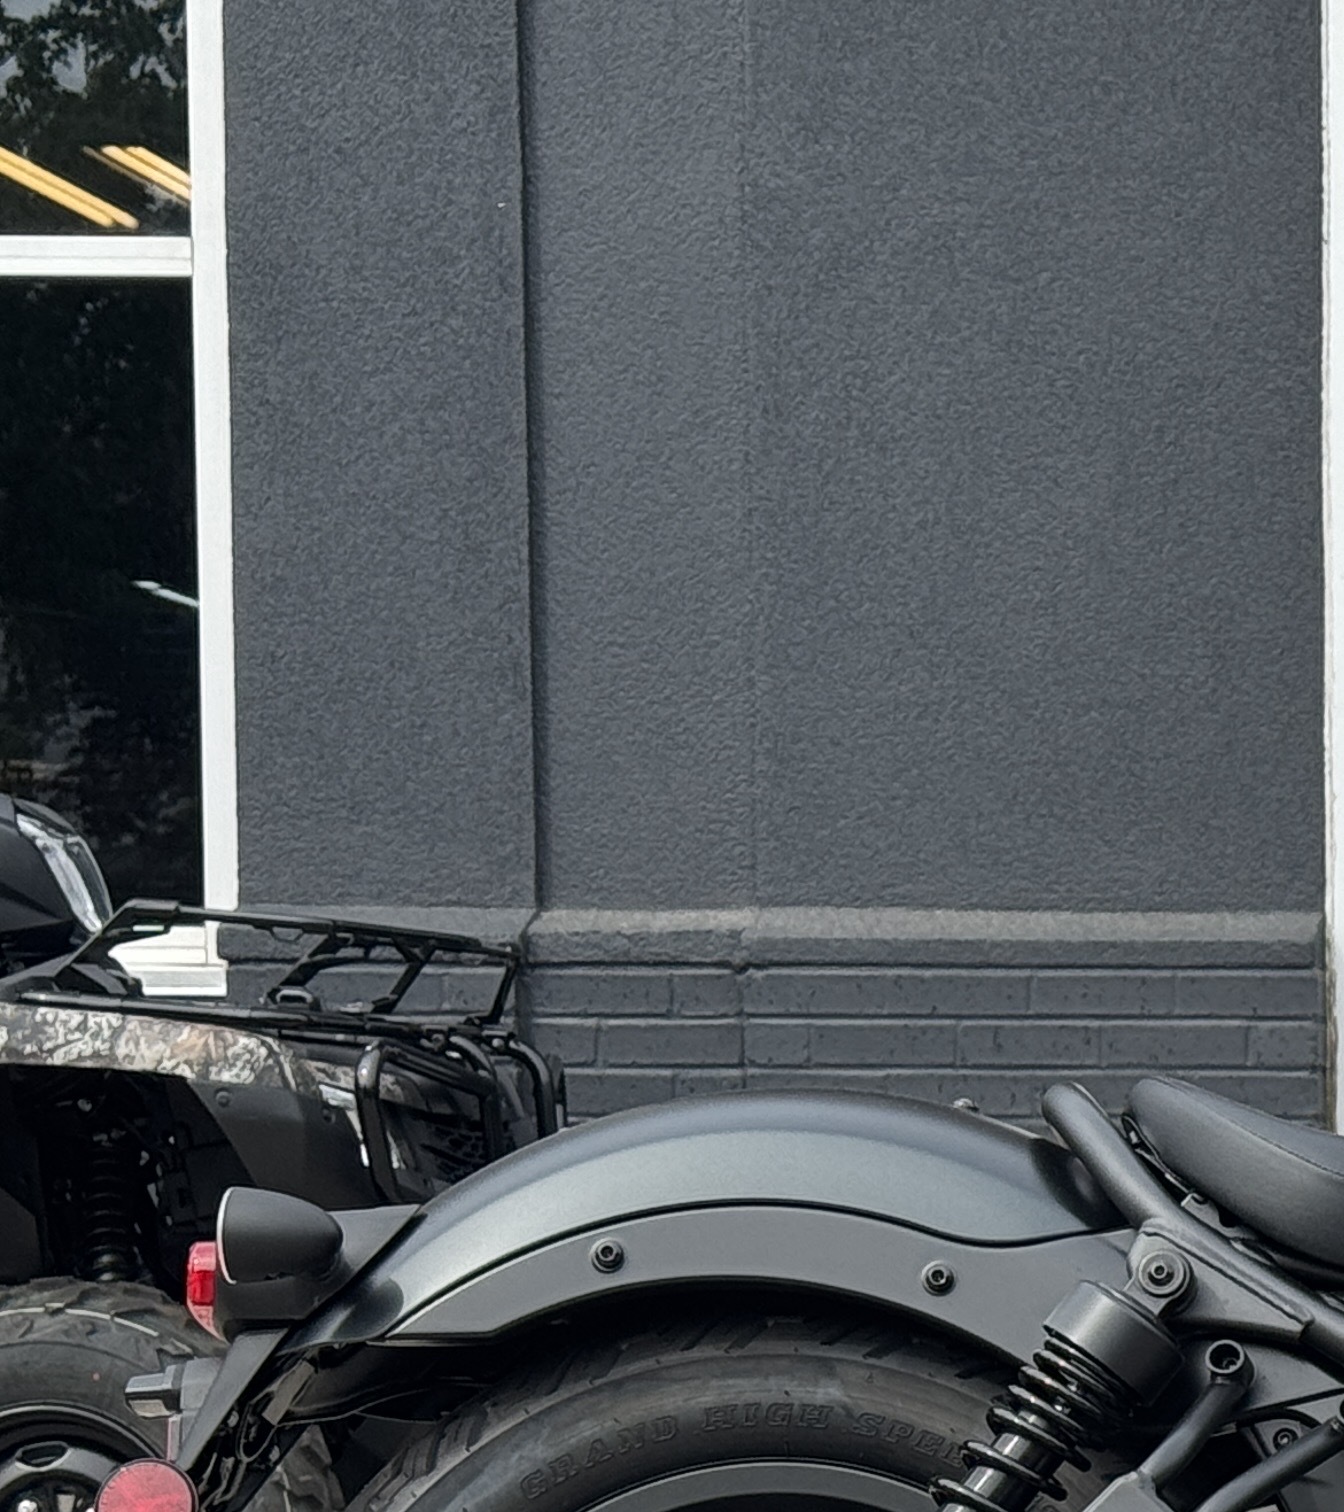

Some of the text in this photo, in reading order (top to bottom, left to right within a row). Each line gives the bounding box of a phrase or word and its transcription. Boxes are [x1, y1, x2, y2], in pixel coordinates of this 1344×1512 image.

[515, 1401, 967, 1501] GRAND HIGH SPEE
